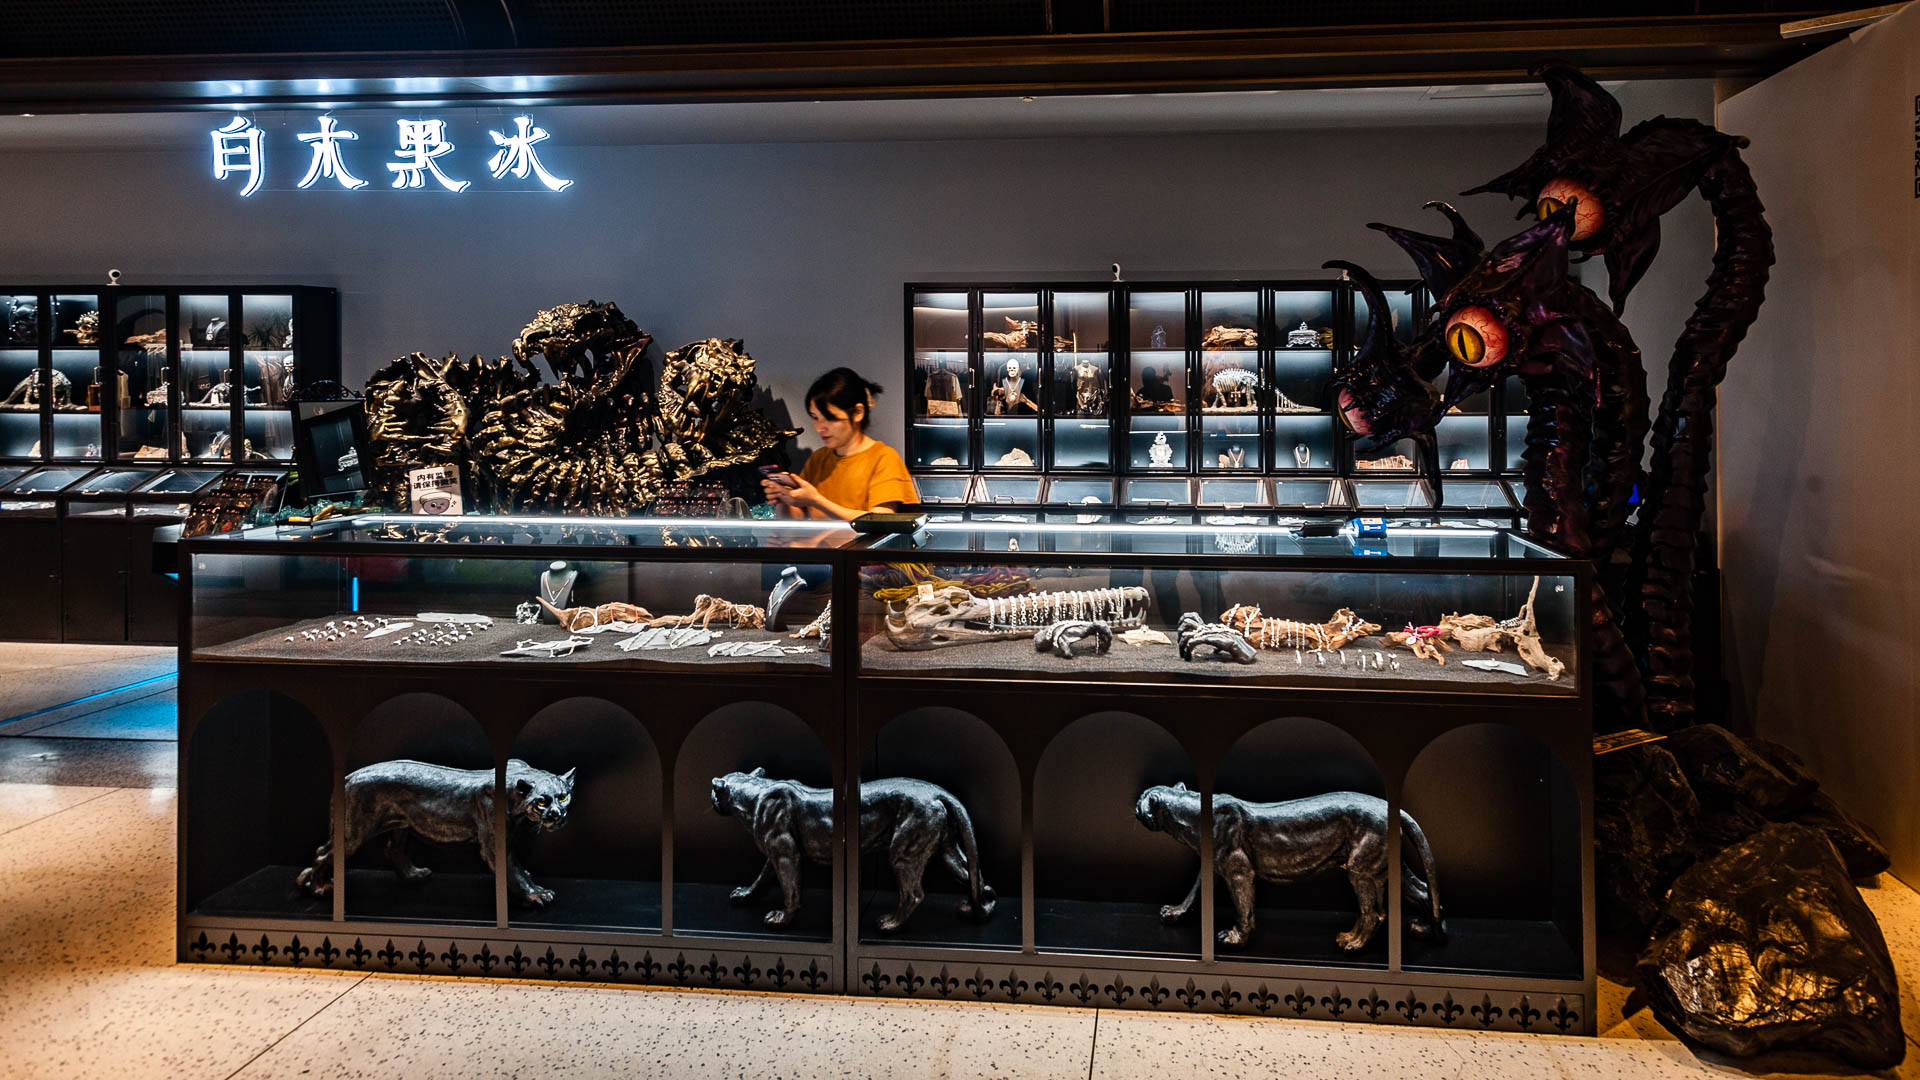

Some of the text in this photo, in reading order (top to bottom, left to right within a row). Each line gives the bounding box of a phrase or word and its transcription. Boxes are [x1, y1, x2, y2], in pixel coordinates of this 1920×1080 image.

[416, 470, 453, 481] 内有监控
[413, 478, 458, 489] 请保持微笑
